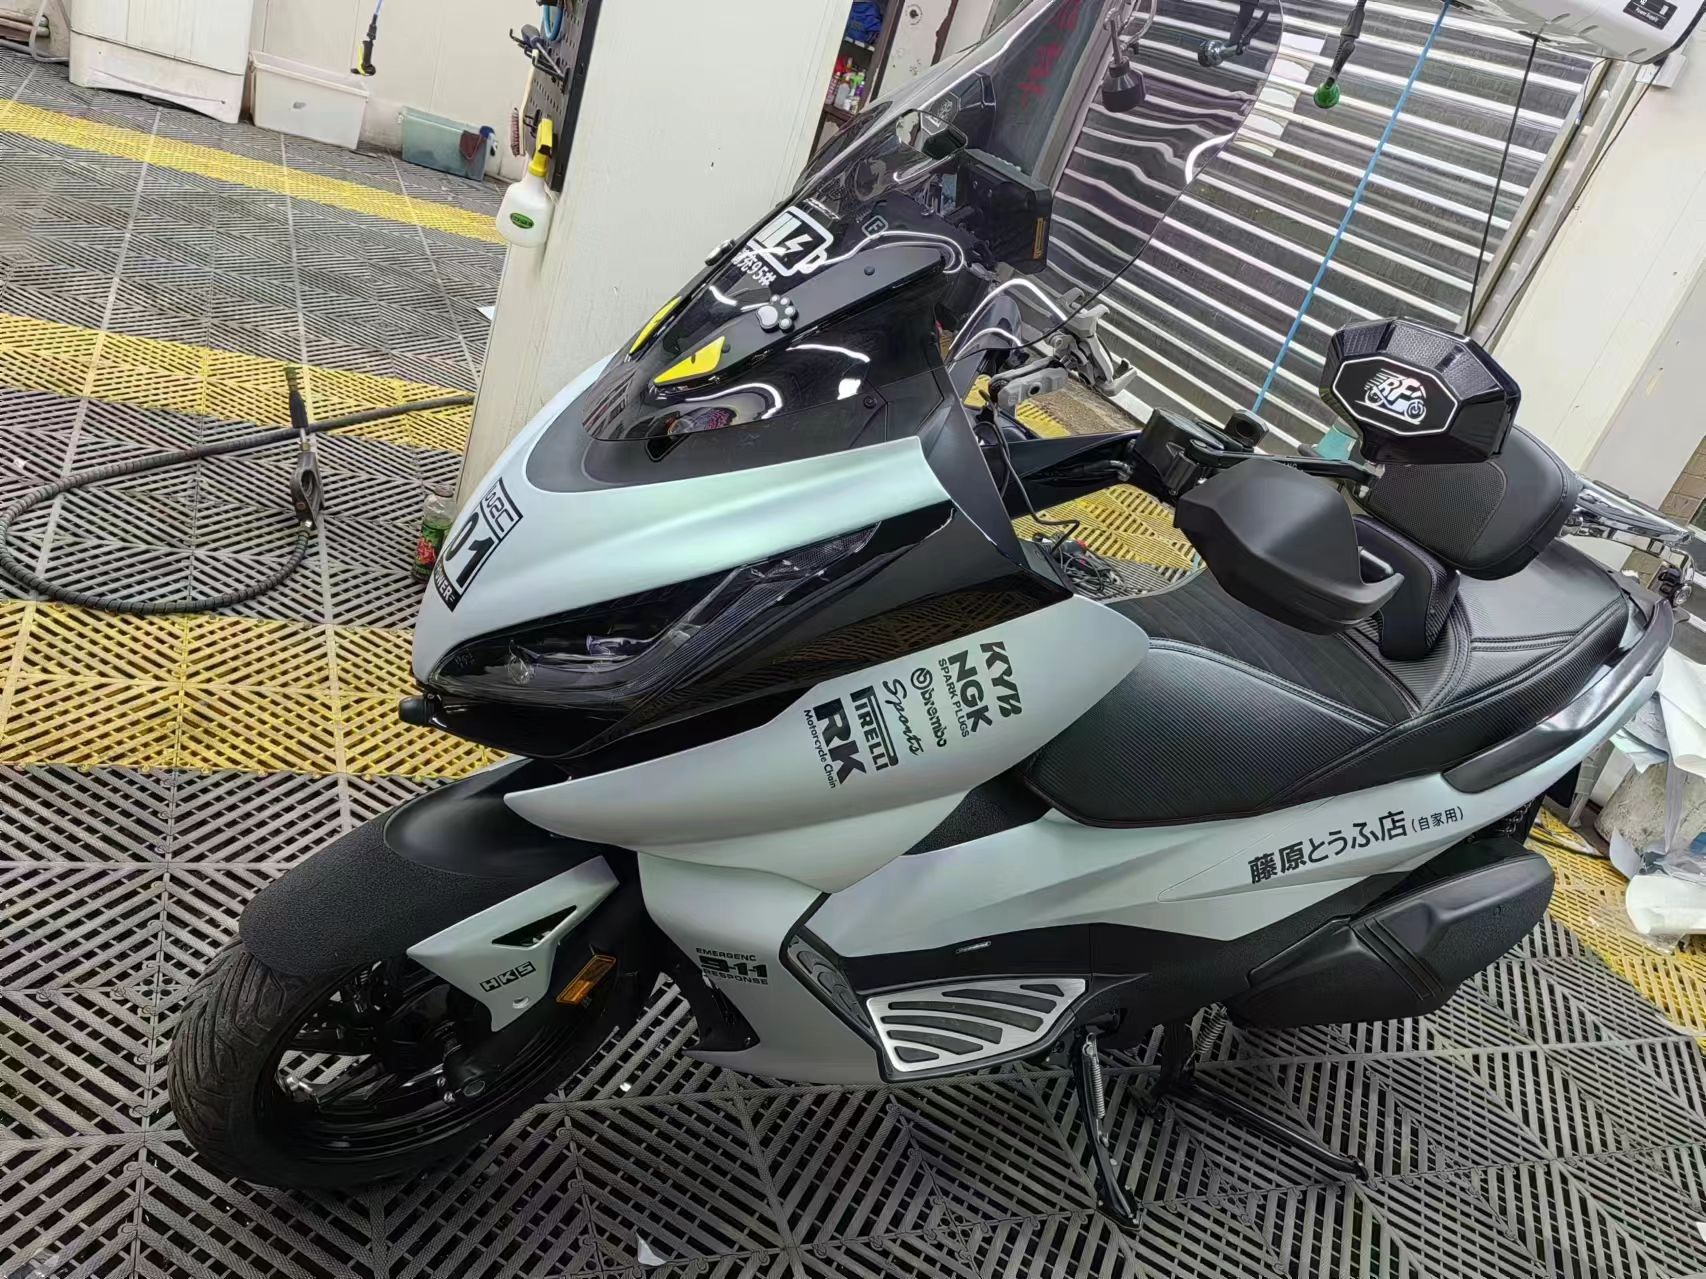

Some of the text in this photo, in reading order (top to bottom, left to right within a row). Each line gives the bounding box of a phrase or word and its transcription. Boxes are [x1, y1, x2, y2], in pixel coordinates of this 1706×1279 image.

[445, 511, 495, 589] 01
[882, 678, 925, 756] Sports
[938, 658, 970, 738] SPARK PLUGS
[947, 650, 993, 733] NGK
[980, 641, 1022, 718] KYB
[803, 708, 836, 789] Motorcycle Chain
[813, 698, 867, 784] RK
[850, 685, 899, 771] PIRELLI
[1248, 806, 1464, 884] 藤原とうふ店 (自家用)
[480, 961, 536, 992] HKS
[696, 948, 757, 962] EMERGENC
[702, 968, 768, 985] RESPONSE
